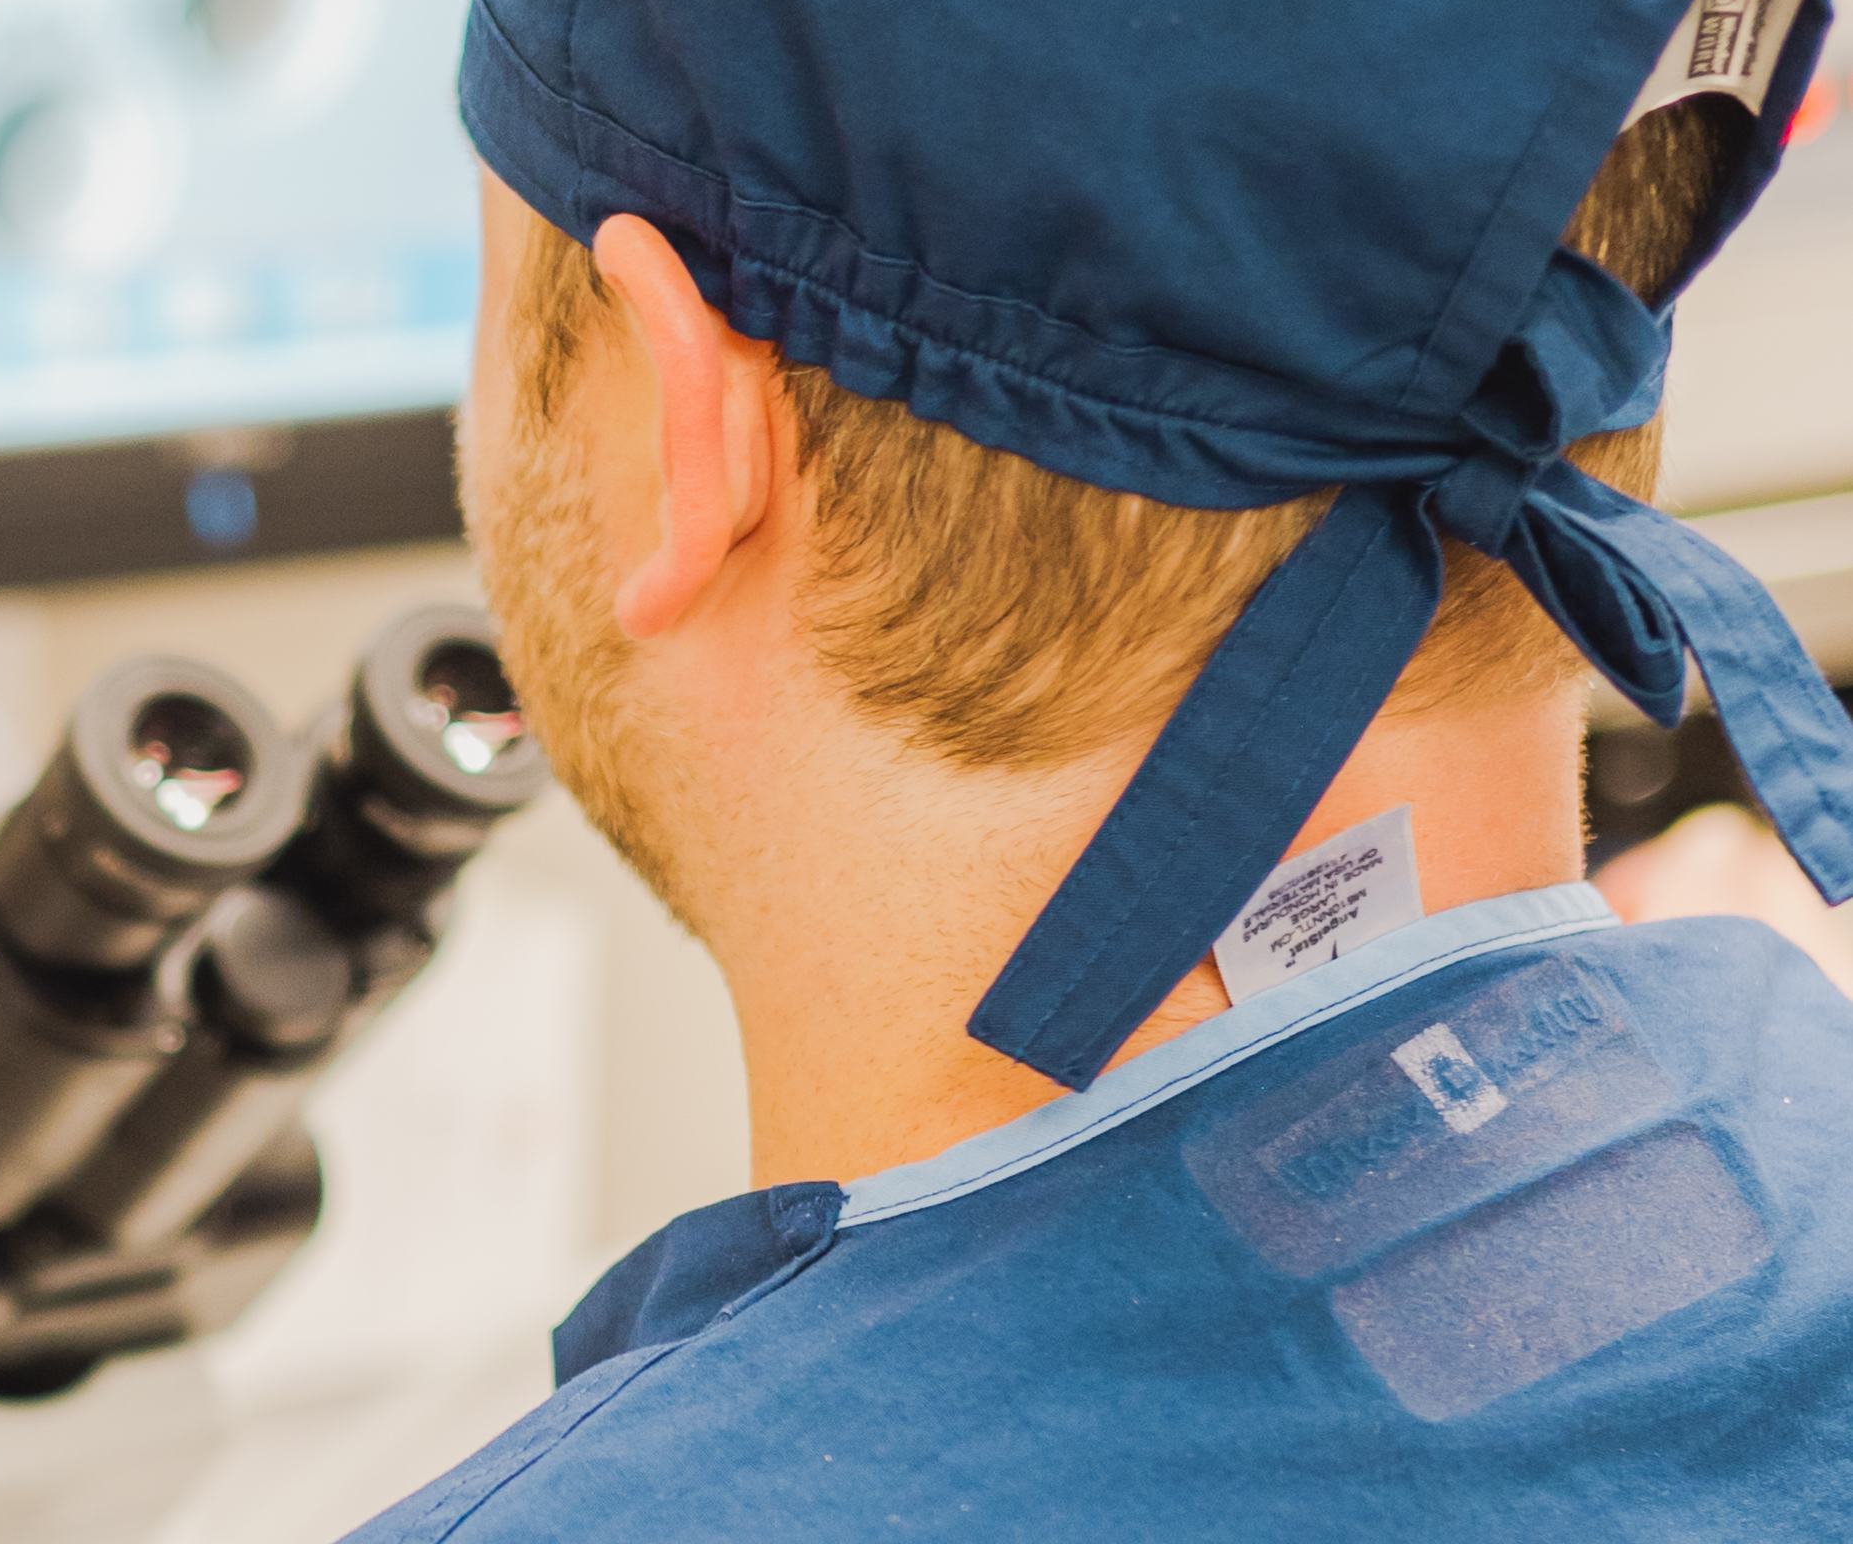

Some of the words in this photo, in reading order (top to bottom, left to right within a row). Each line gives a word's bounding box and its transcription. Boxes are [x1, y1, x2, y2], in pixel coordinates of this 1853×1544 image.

[1358, 849, 1377, 863] OF
[1324, 861, 1353, 879] USA
[1343, 857, 1382, 882] MADE
[1324, 880, 1338, 891] IN
[1244, 888, 1320, 942] HONDURAS
[1290, 892, 1336, 924] LARGE
